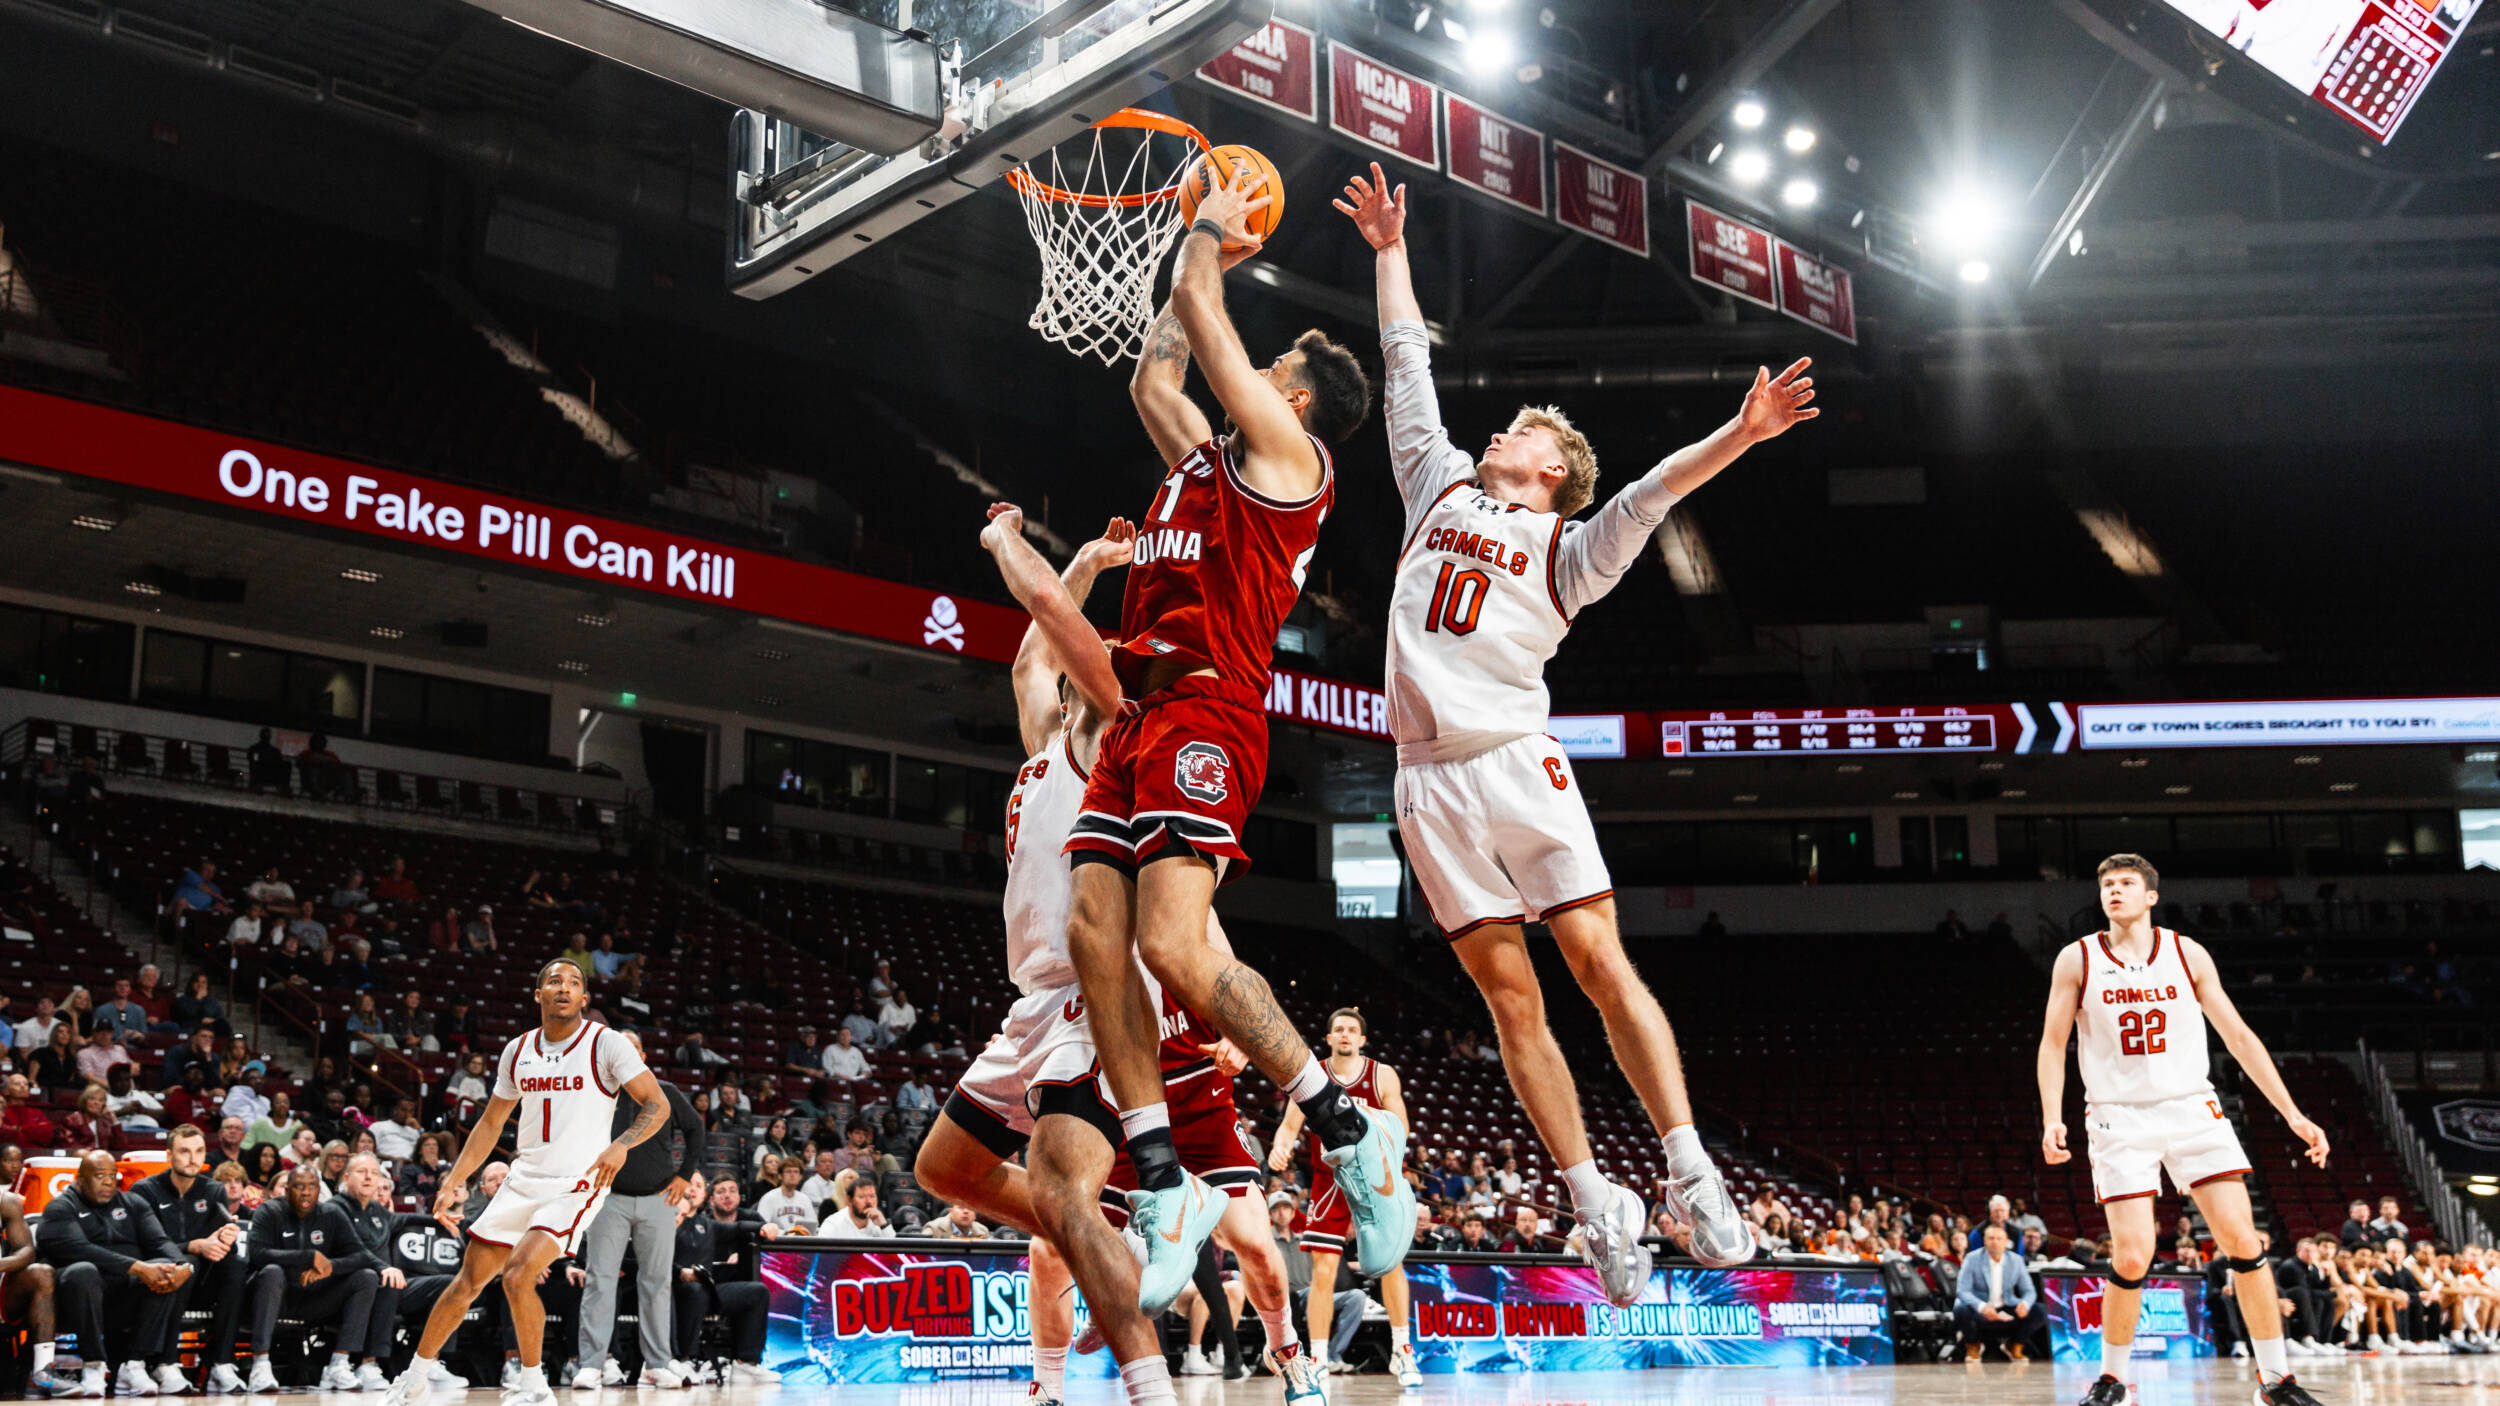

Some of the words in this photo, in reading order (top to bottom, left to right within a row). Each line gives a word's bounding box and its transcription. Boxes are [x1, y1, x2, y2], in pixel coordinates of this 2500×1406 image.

[1355, 60, 1412, 113] NCAA
[1479, 115, 1510, 155] NIT
[1587, 162, 1614, 198] NIT
[1715, 220, 1749, 256] SEC
[217, 448, 330, 513] One
[344, 474, 466, 542] Fake
[478, 503, 551, 561] Pill
[563, 524, 653, 583] Can
[666, 544, 735, 600] Kill
[1425, 527, 1529, 577] CAMELS
[1424, 560, 1492, 637] 10
[1301, 678, 1393, 735] KILLER
[2090, 721, 2122, 733] OUT
[2126, 721, 2147, 733] OF
[2152, 720, 2200, 733] TOWN
[2203, 719, 2265, 731] SCORES
[2268, 718, 2343, 730] BROUGHT
[2349, 717, 2369, 729] TO
[2374, 717, 2406, 728] YOU
[1542, 756, 1568, 790] C
[2102, 984, 2178, 1004] CAMELS
[2118, 1008, 2166, 1056] 22
[519, 1075, 584, 1093] CAMELS
[542, 1097, 552, 1143] 1
[834, 1264, 972, 1336] BUZZED
[971, 1275, 1016, 1337] IS
[1768, 1301, 1809, 1327] SOBER
[1823, 1302, 1880, 1326] SLAMMER
[912, 1316, 973, 1337] DRIVING
[1417, 1302, 1498, 1338] BUZZED
[1502, 1302, 1588, 1337] DRIVING
[1591, 1303, 1613, 1337] IS
[1616, 1303, 1683, 1337] DRUNK
[1685, 1303, 1762, 1337] DRIVING
[899, 1345, 951, 1368] SOBER
[972, 1344, 1034, 1367] SLAMME
